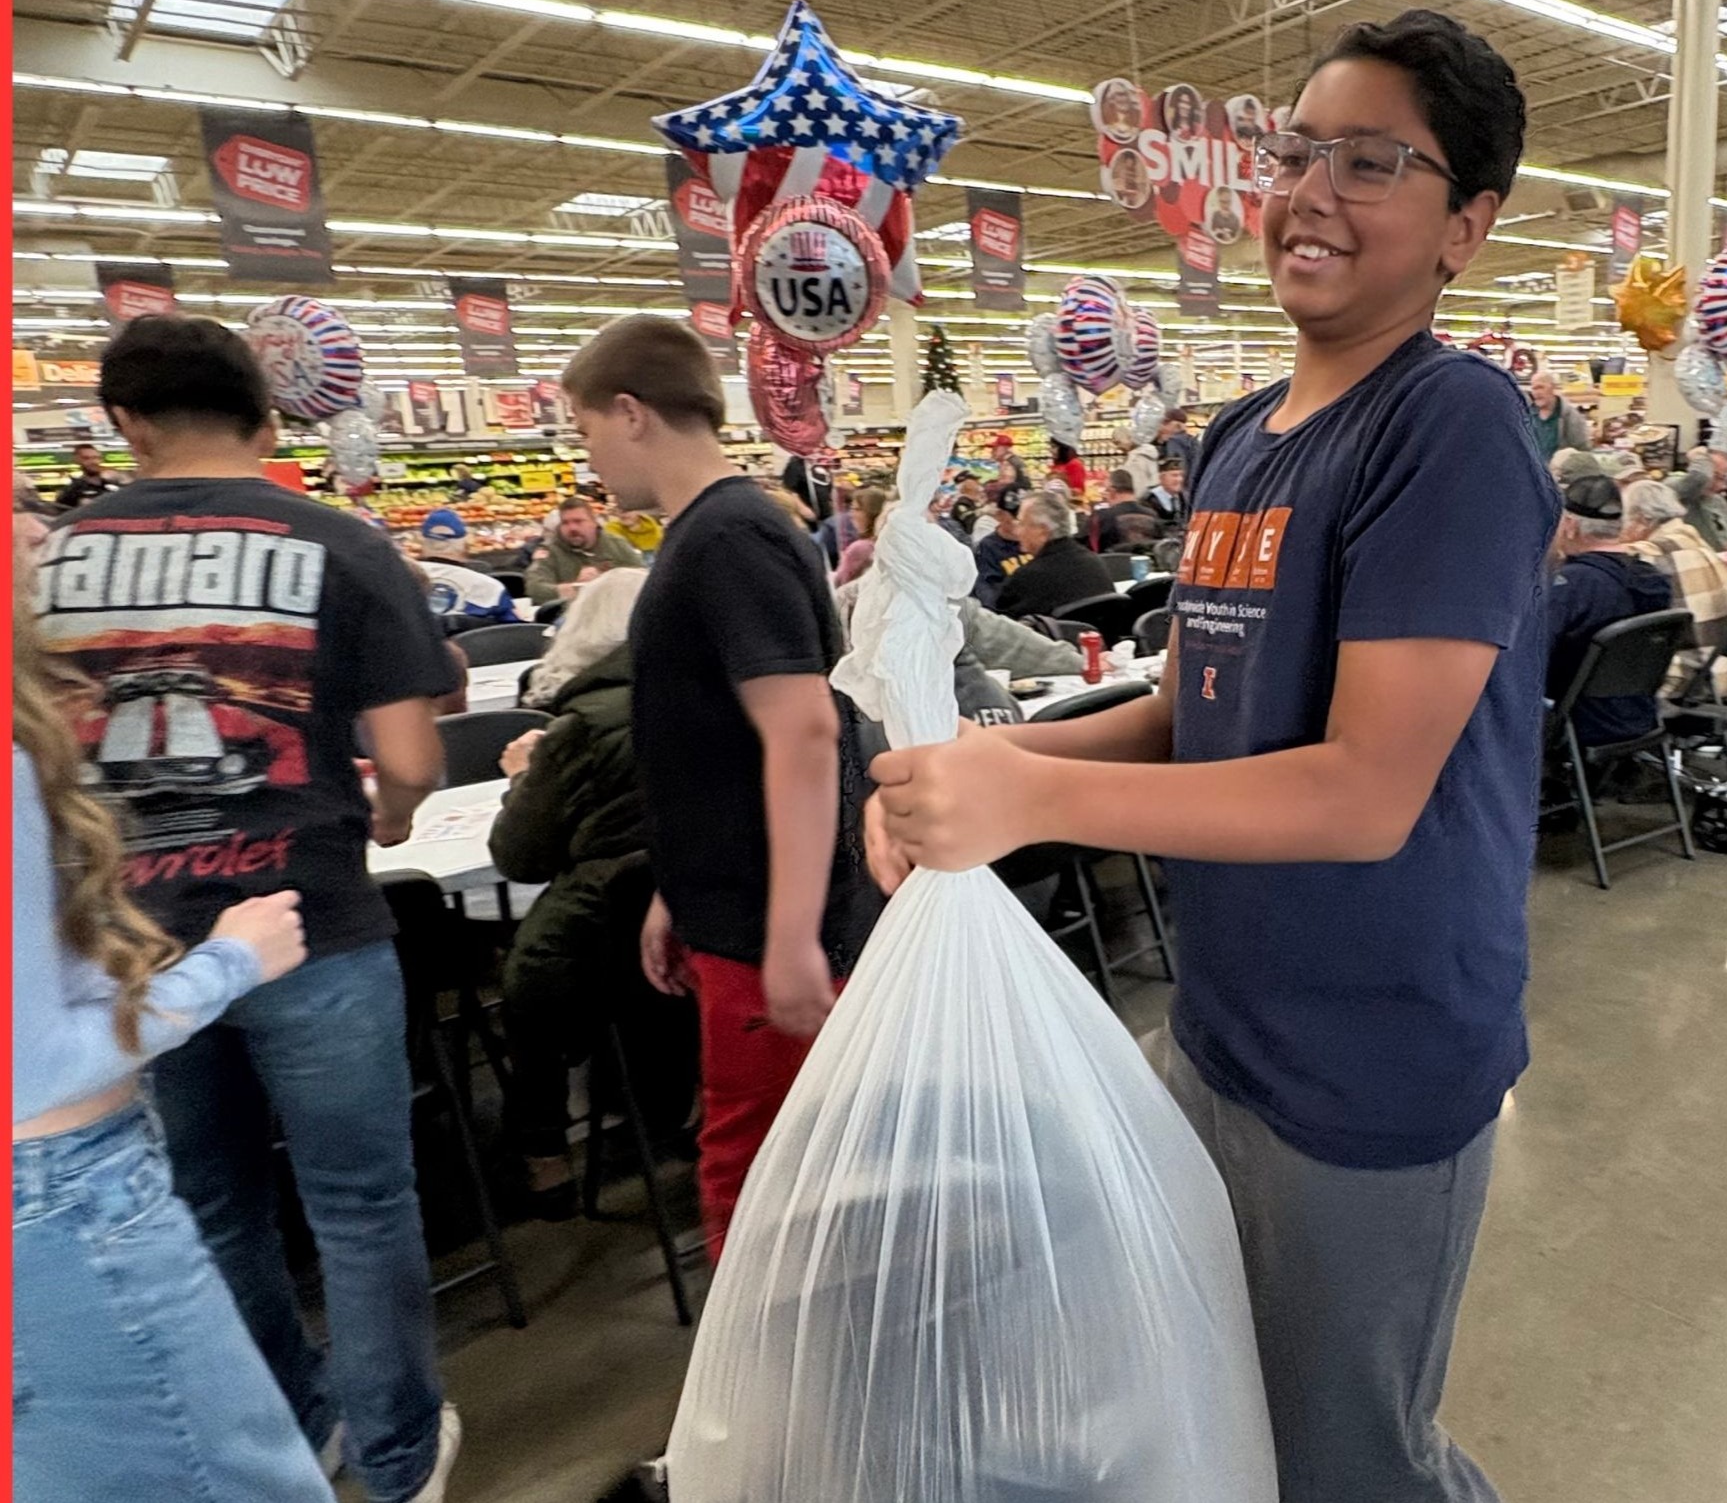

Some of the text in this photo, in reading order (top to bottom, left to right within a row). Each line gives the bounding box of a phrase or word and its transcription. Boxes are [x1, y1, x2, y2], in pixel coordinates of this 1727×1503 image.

[238, 152, 303, 186] LOW
[1137, 125, 1252, 193] SMIL
[770, 276, 854, 318] USA
[1237, 603, 1266, 619] Science
